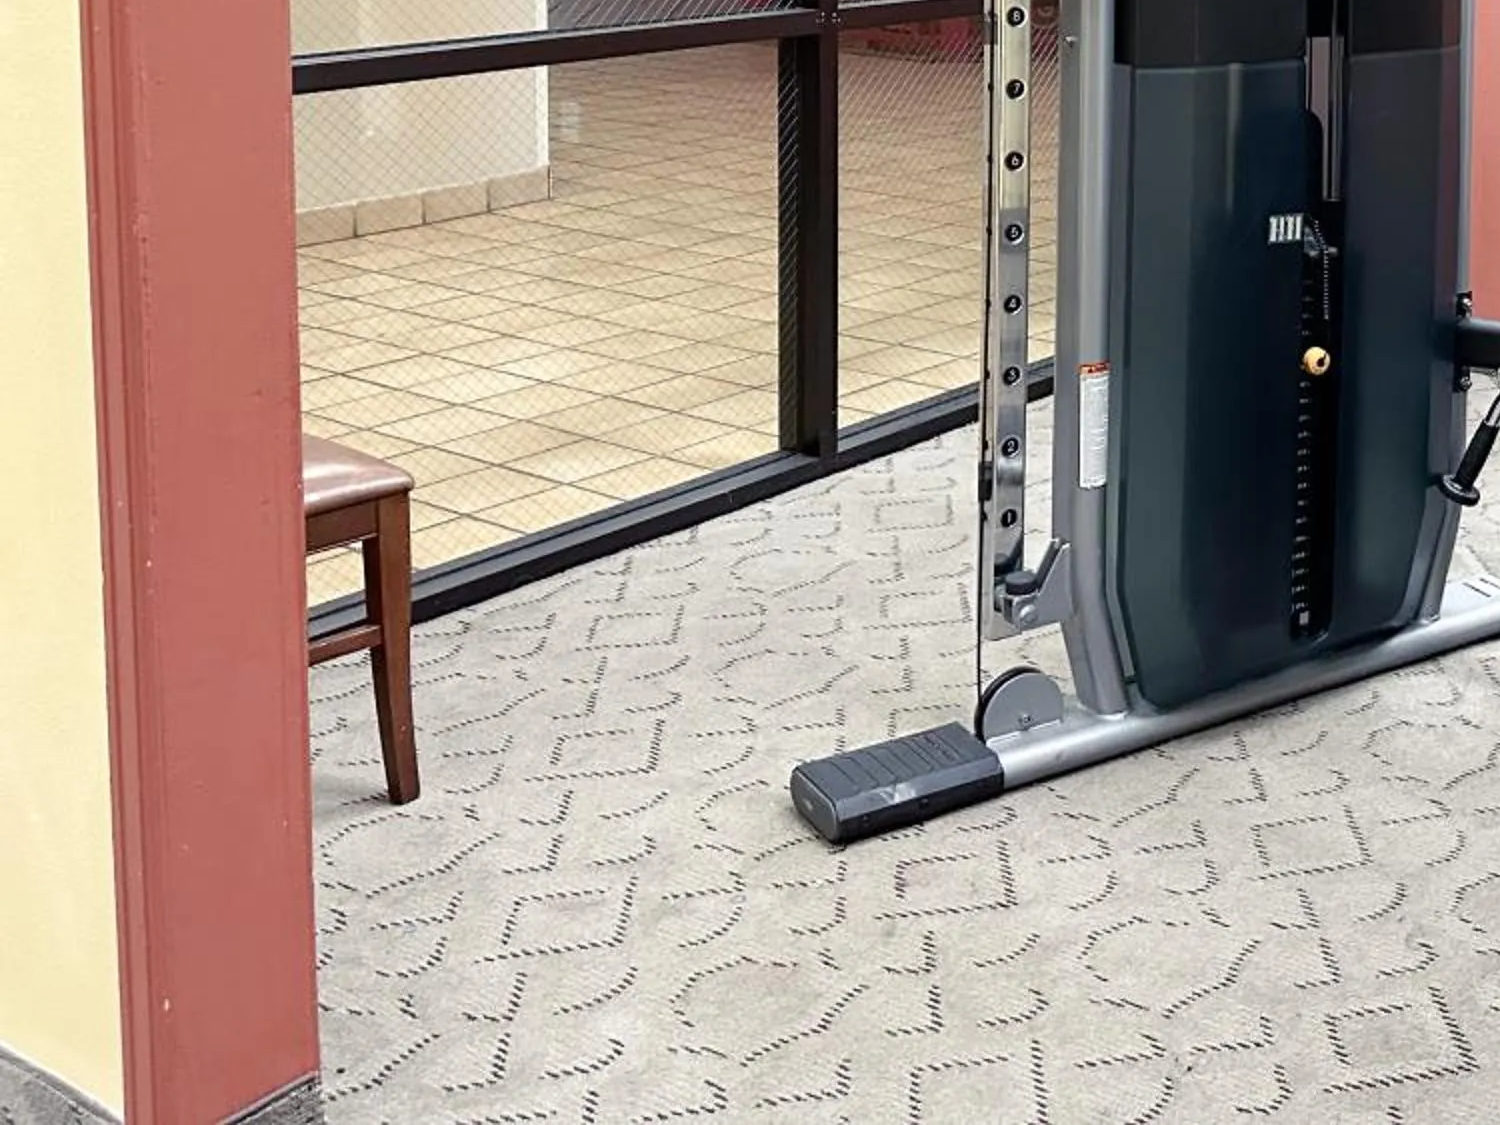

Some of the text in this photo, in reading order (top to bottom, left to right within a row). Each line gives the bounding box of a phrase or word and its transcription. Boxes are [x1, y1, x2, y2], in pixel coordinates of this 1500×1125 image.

[1014, 10, 1021, 23] 8
[1012, 155, 1019, 166] 6
[1010, 226, 1018, 238] 5
[1009, 298, 1017, 309] 4
[1008, 369, 1017, 381] 3
[1007, 440, 1015, 452] 2
[1006, 511, 1012, 524] 1
